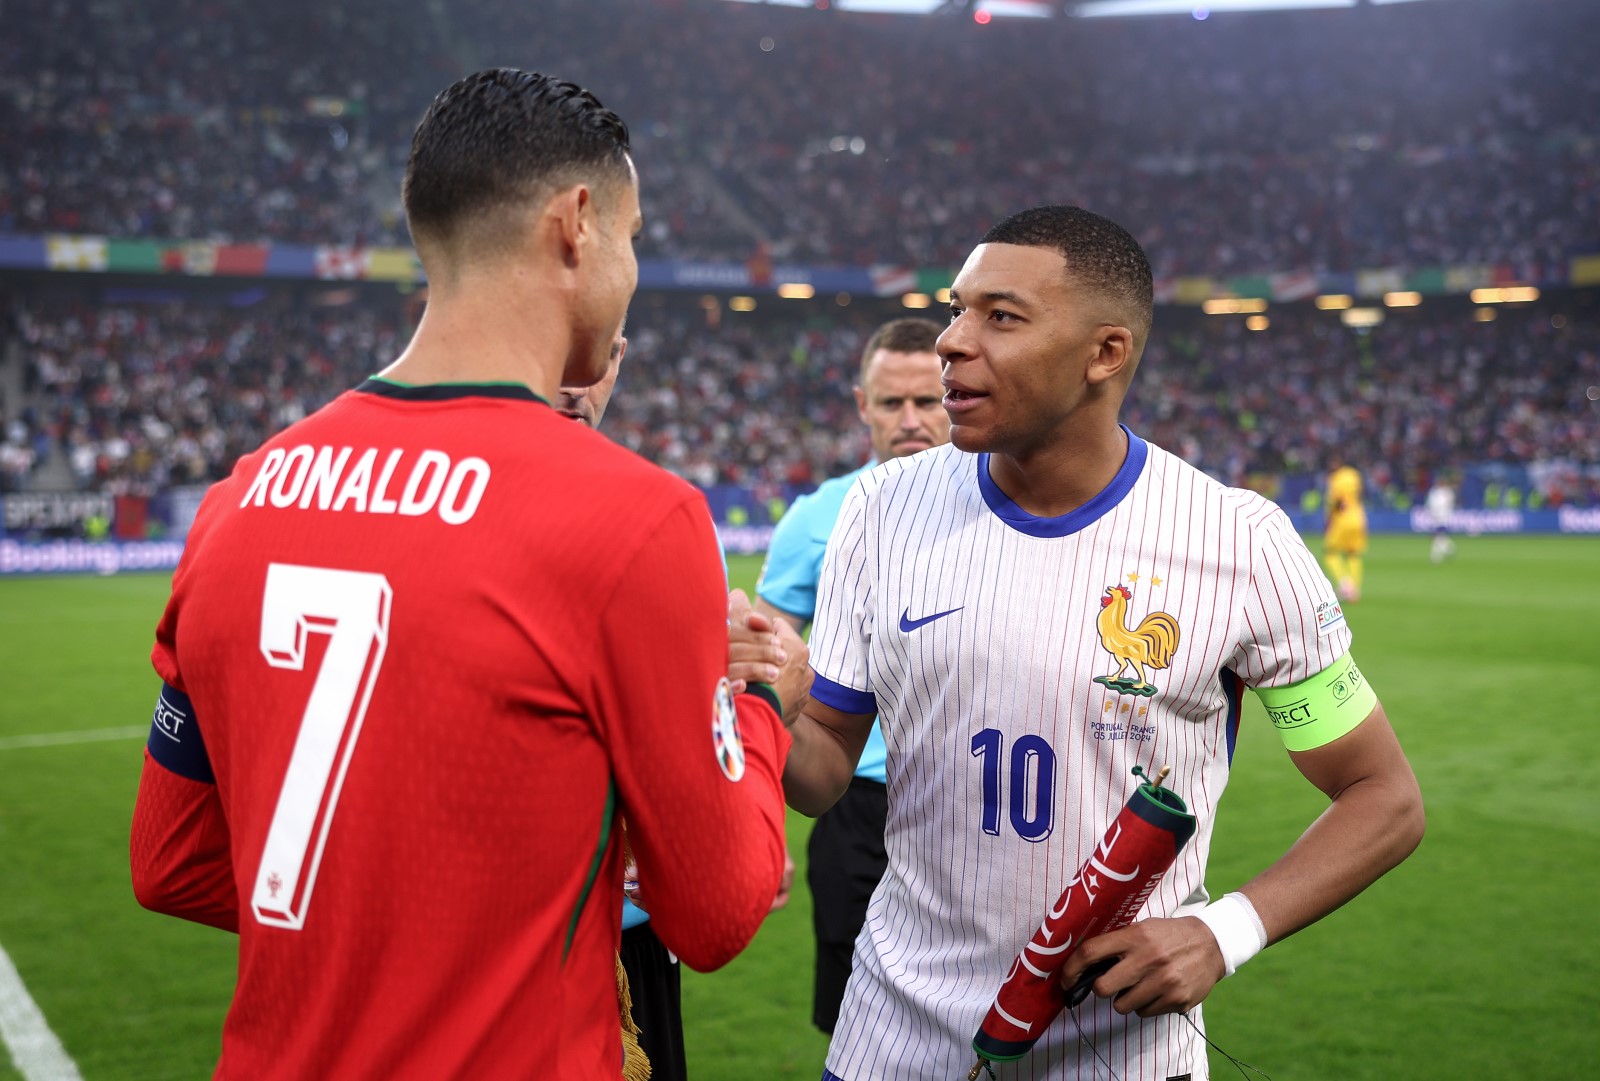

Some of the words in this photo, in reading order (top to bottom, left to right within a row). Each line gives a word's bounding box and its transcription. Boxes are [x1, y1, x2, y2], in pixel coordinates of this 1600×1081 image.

[239, 444, 491, 525] RONALDO
[251, 562, 393, 931] 7
[1091, 722, 1123, 731] PORTUGAL
[1131, 724, 1155, 734] FRANCE
[1130, 733, 1151, 742] 2024
[971, 728, 1057, 843] 10
